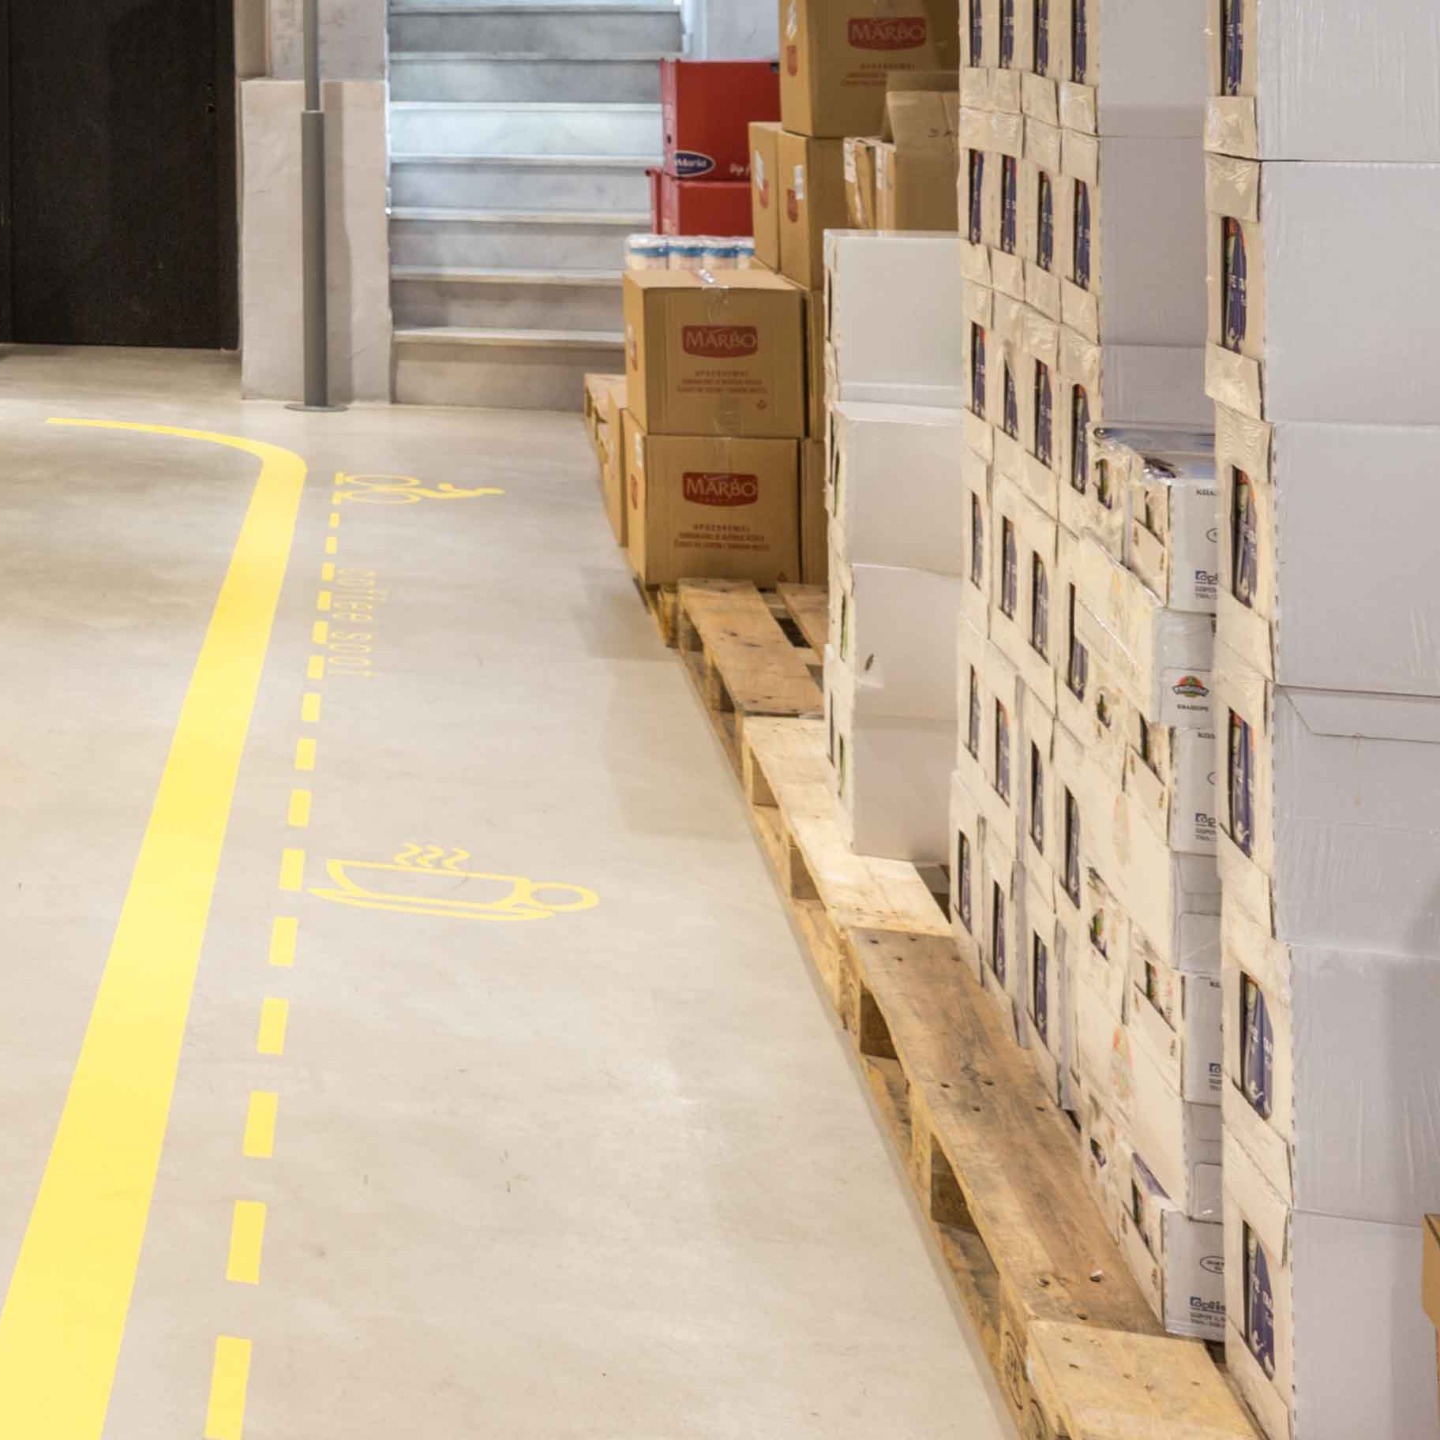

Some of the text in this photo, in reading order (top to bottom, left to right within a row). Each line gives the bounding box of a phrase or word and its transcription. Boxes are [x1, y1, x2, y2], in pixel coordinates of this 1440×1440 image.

[850, 23, 925, 41] MARBO
[685, 330, 756, 349] MARBO
[685, 477, 756, 498] MARBO
